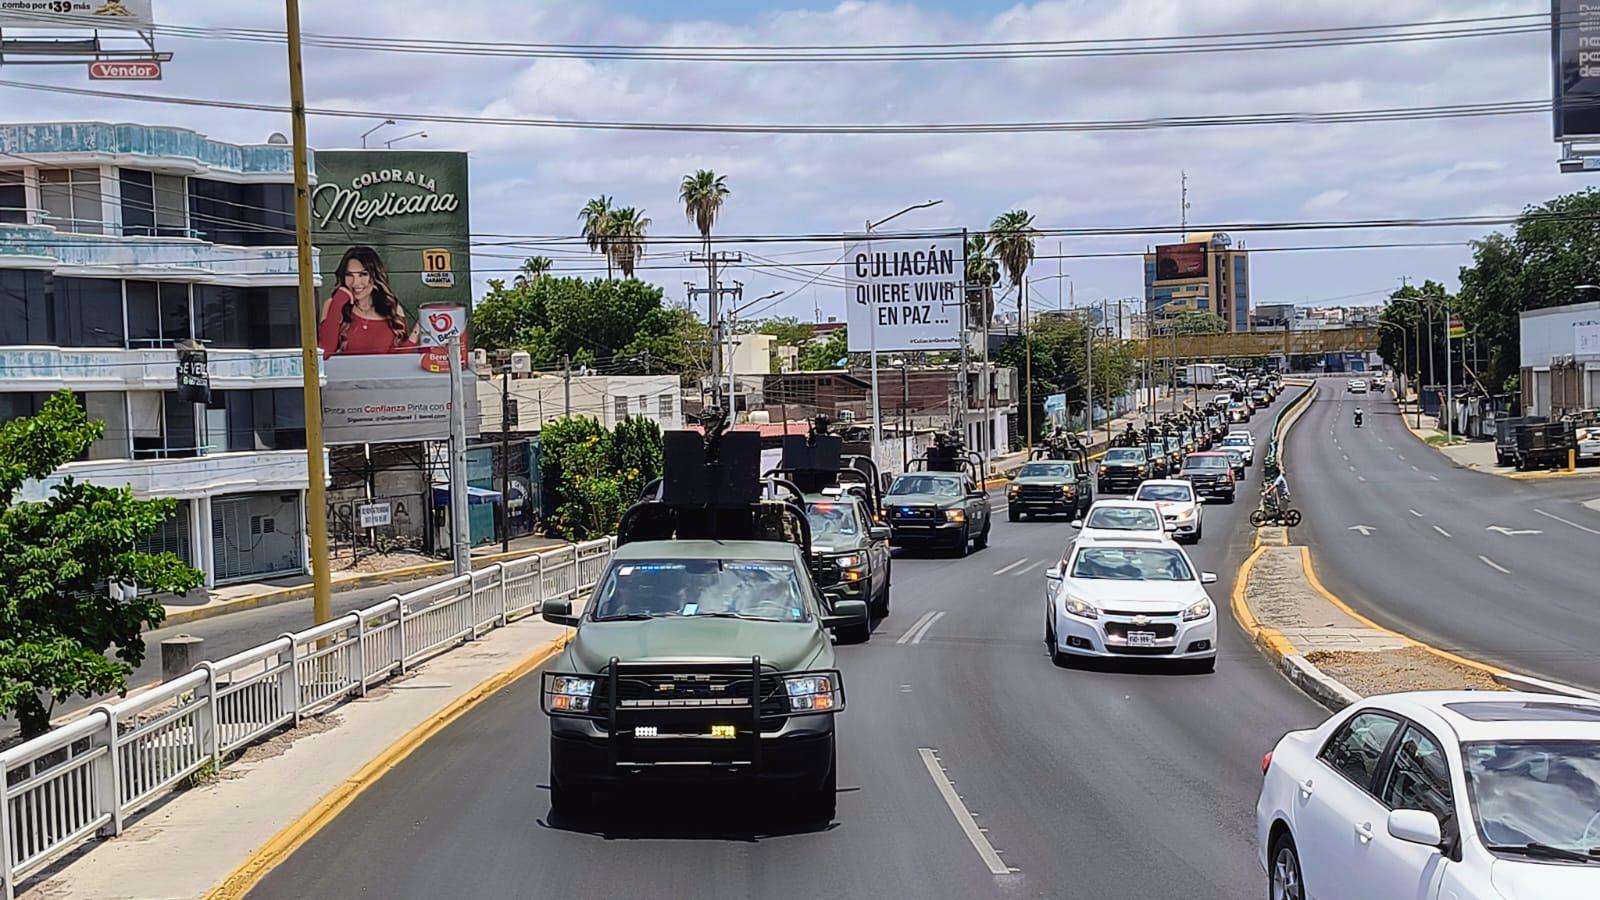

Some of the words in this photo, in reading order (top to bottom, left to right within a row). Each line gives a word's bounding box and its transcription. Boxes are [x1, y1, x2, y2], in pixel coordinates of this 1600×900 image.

[1, 1, 31, 9] combo
[32, 2, 47, 10] por
[48, 1, 72, 12] $39
[99, 64, 153, 77] Vendor
[352, 169, 403, 190] COLOR
[404, 170, 416, 185] A
[418, 174, 436, 192] LA
[311, 183, 459, 229] Mexicana
[427, 255, 446, 270] 10
[855, 245, 954, 278] CULIACÁN
[856, 283, 911, 305] QUIERE
[914, 281, 954, 302] VIVIR
[878, 306, 898, 326] EN
[902, 305, 931, 325] PAZ
[324, 407, 346, 415] Pinta
[347, 406, 363, 414] con
[364, 404, 406, 413] Confianza
[407, 402, 428, 411] Pinta
[429, 402, 445, 410] con
